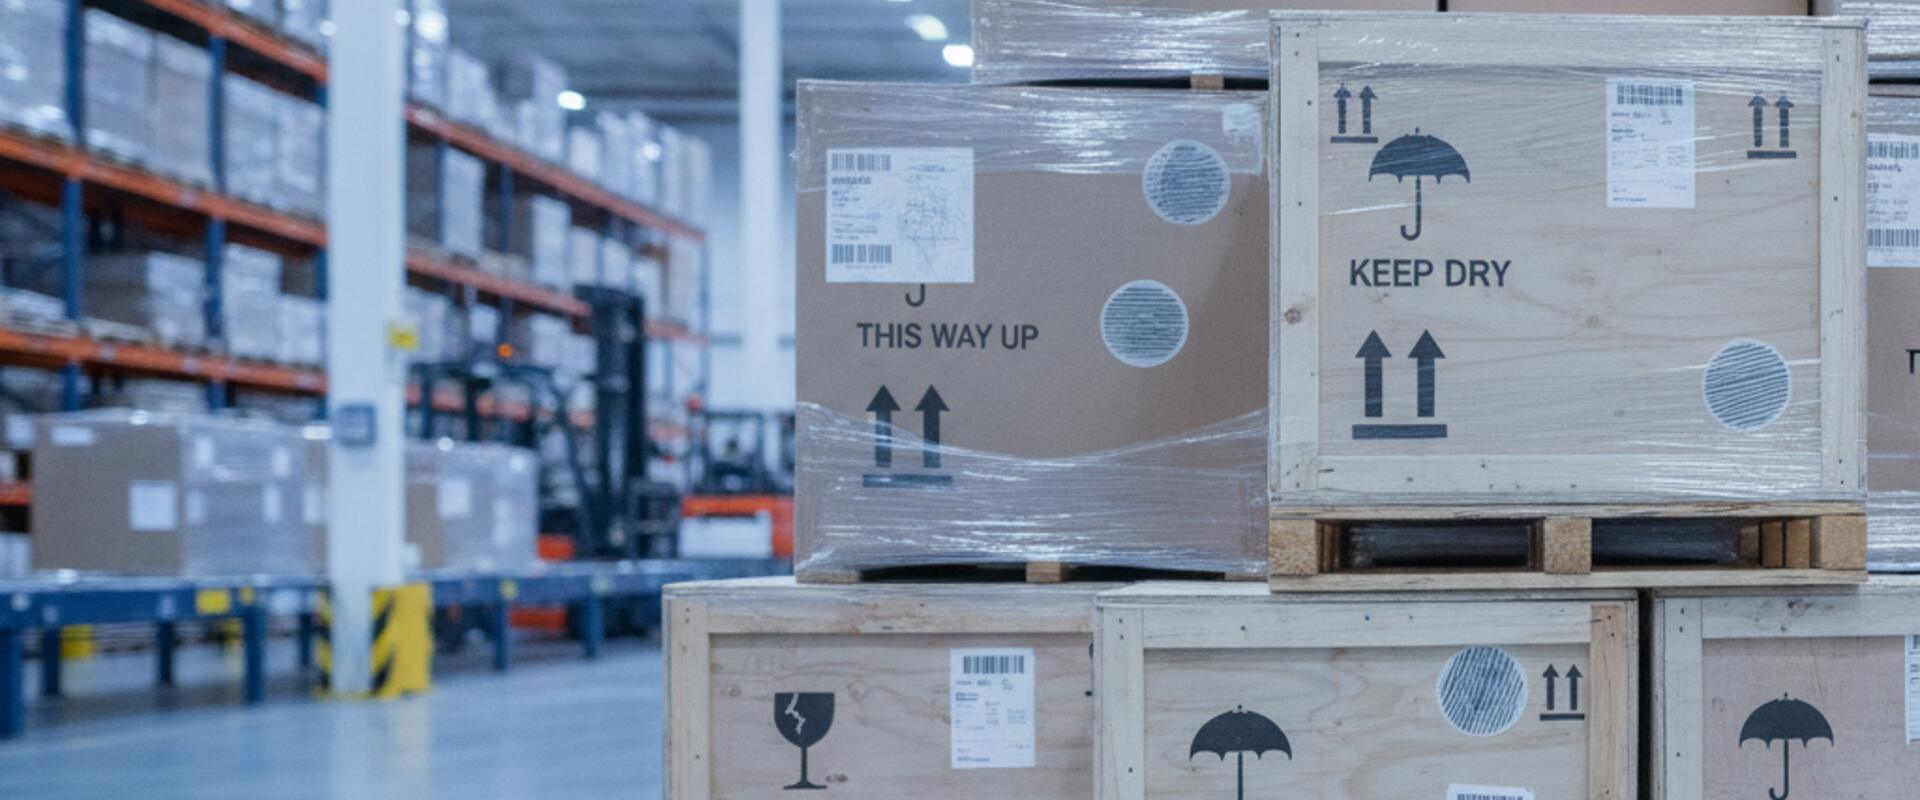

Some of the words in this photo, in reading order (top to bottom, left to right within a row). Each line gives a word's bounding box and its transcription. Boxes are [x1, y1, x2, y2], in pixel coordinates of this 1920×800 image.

[1350, 258, 1434, 287] KEEP
[1445, 259, 1512, 287] DRY
[856, 322, 922, 349] THIS
[931, 323, 993, 349] WAY
[1002, 324, 1040, 350] UP
